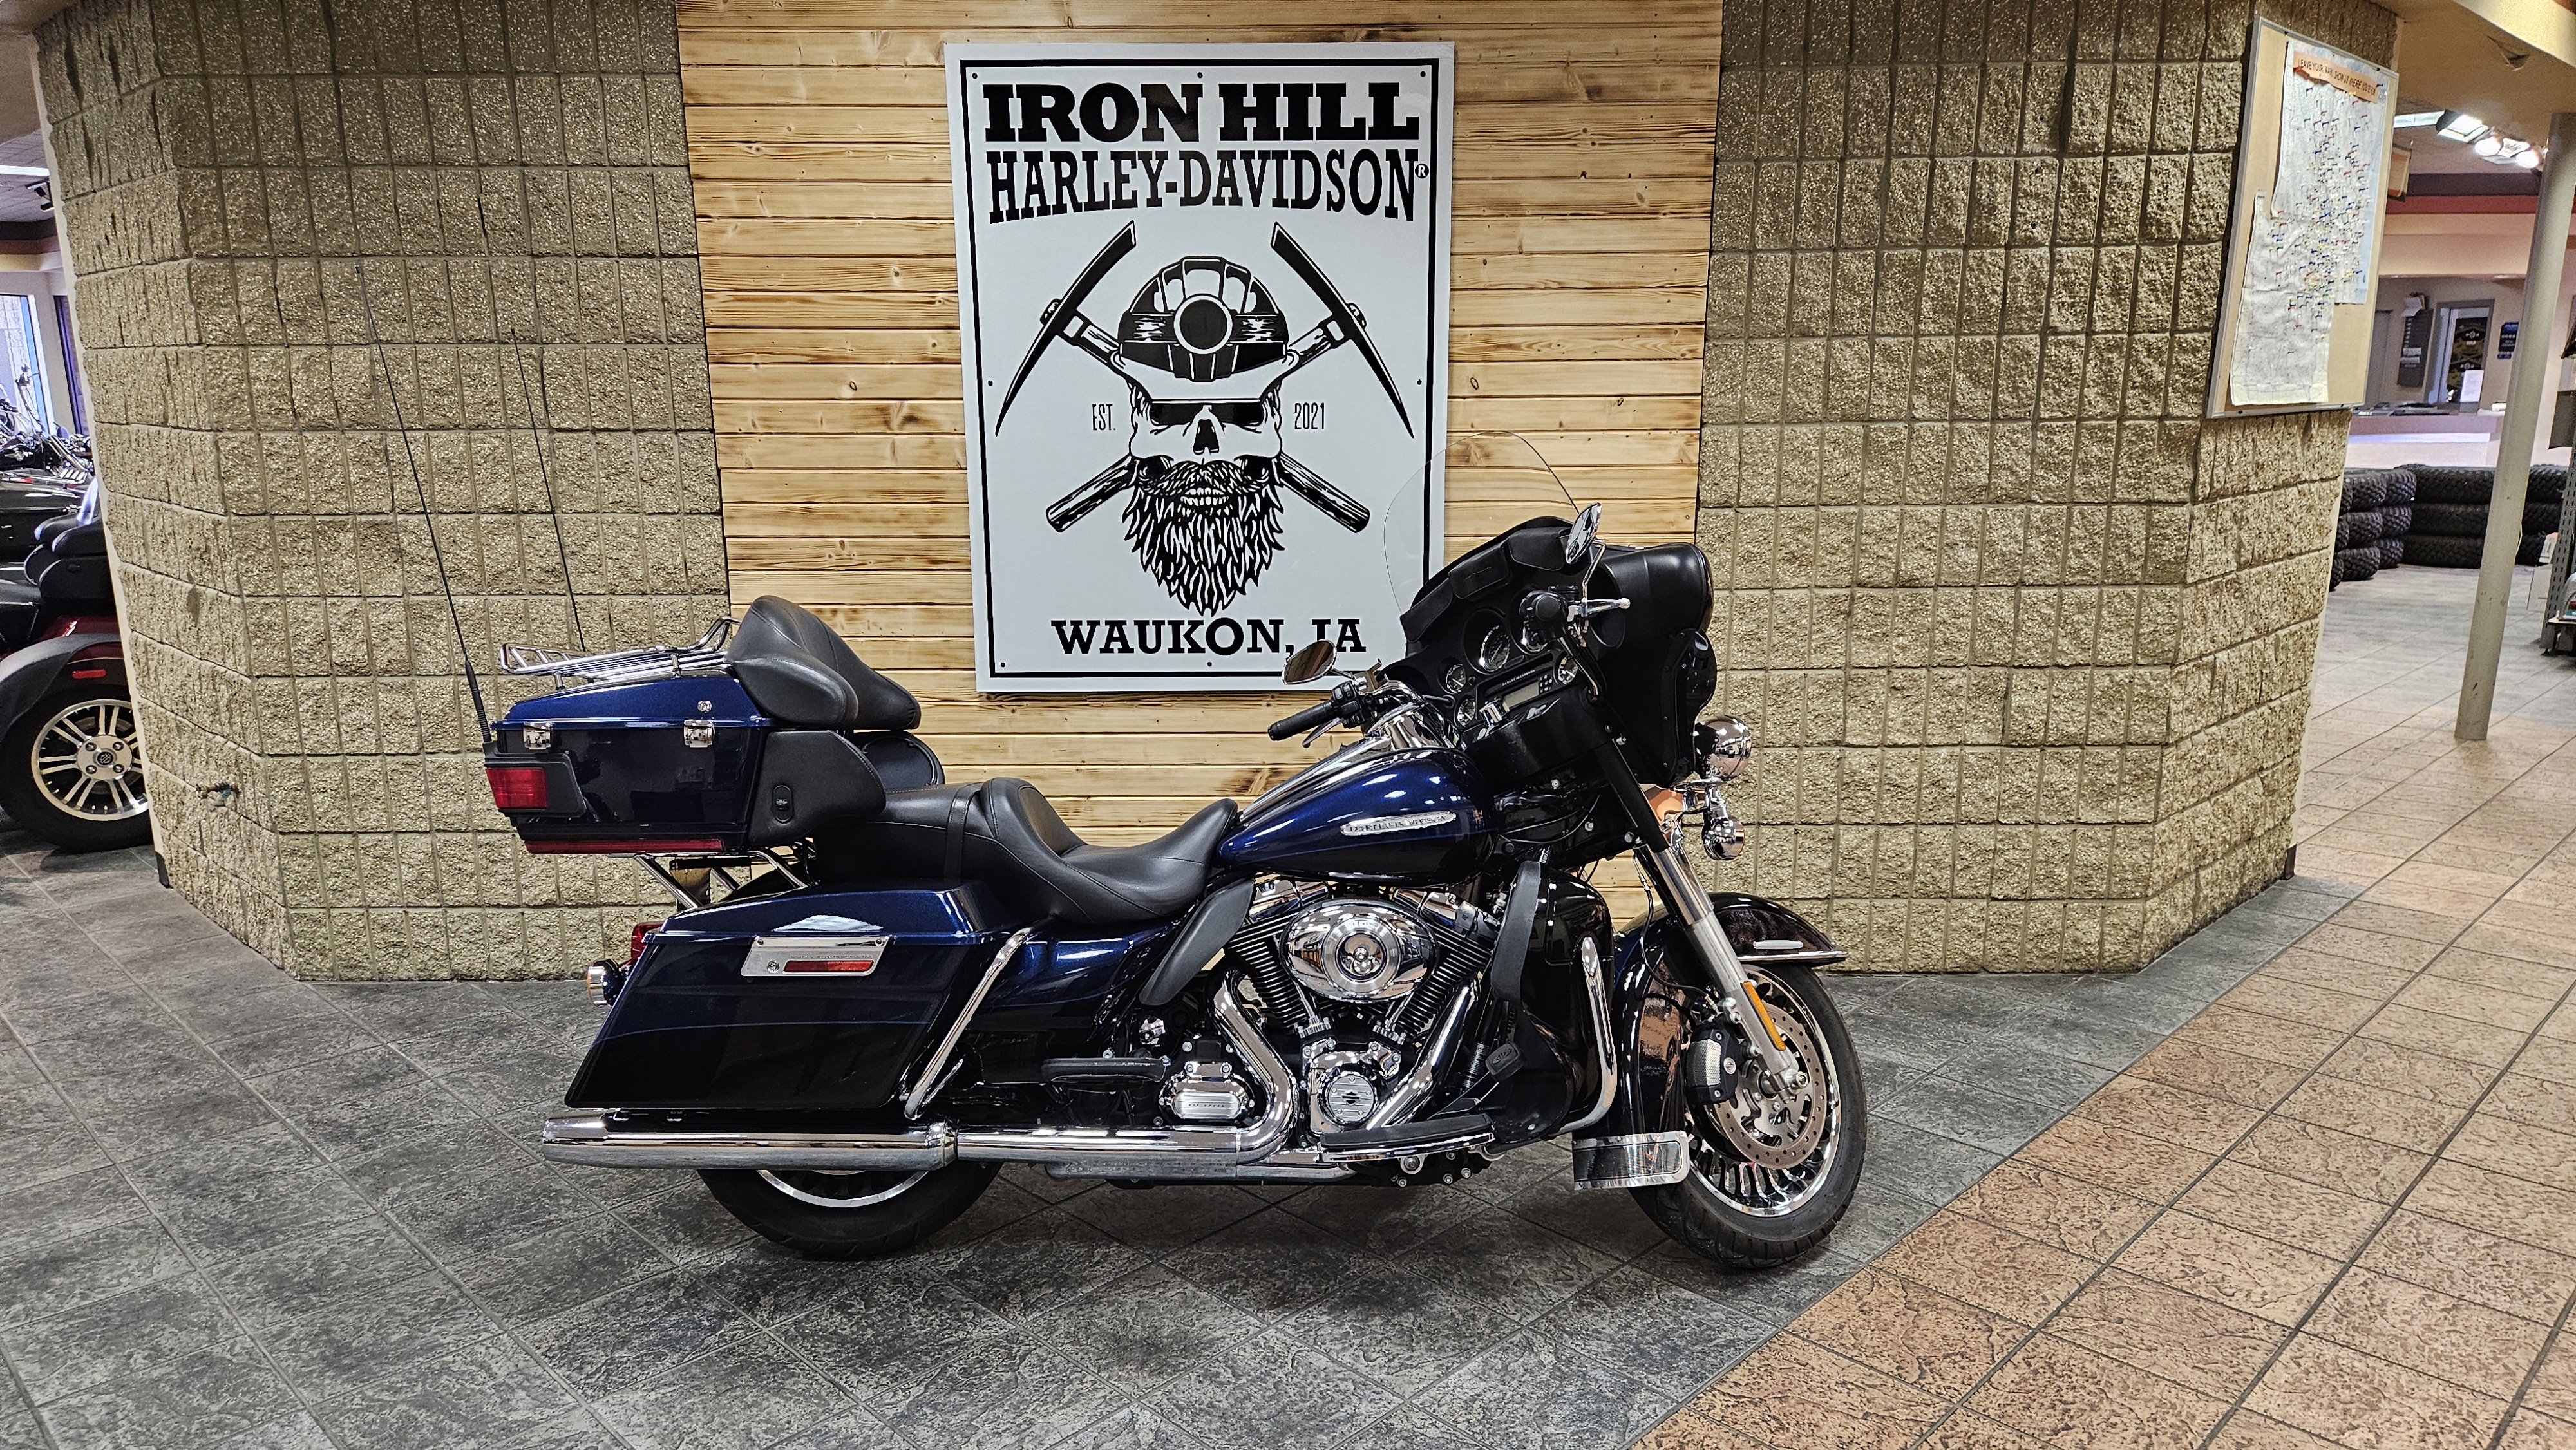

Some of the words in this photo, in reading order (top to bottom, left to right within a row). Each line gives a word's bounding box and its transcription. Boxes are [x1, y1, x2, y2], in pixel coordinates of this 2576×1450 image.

[983, 82, 1204, 143] IRON
[1218, 82, 1419, 142] HILL
[1092, 404, 1116, 431] EST.
[1294, 402, 1325, 429] 2021
[1050, 617, 1294, 659] WAUKON,
[1312, 619, 1367, 652] IA
